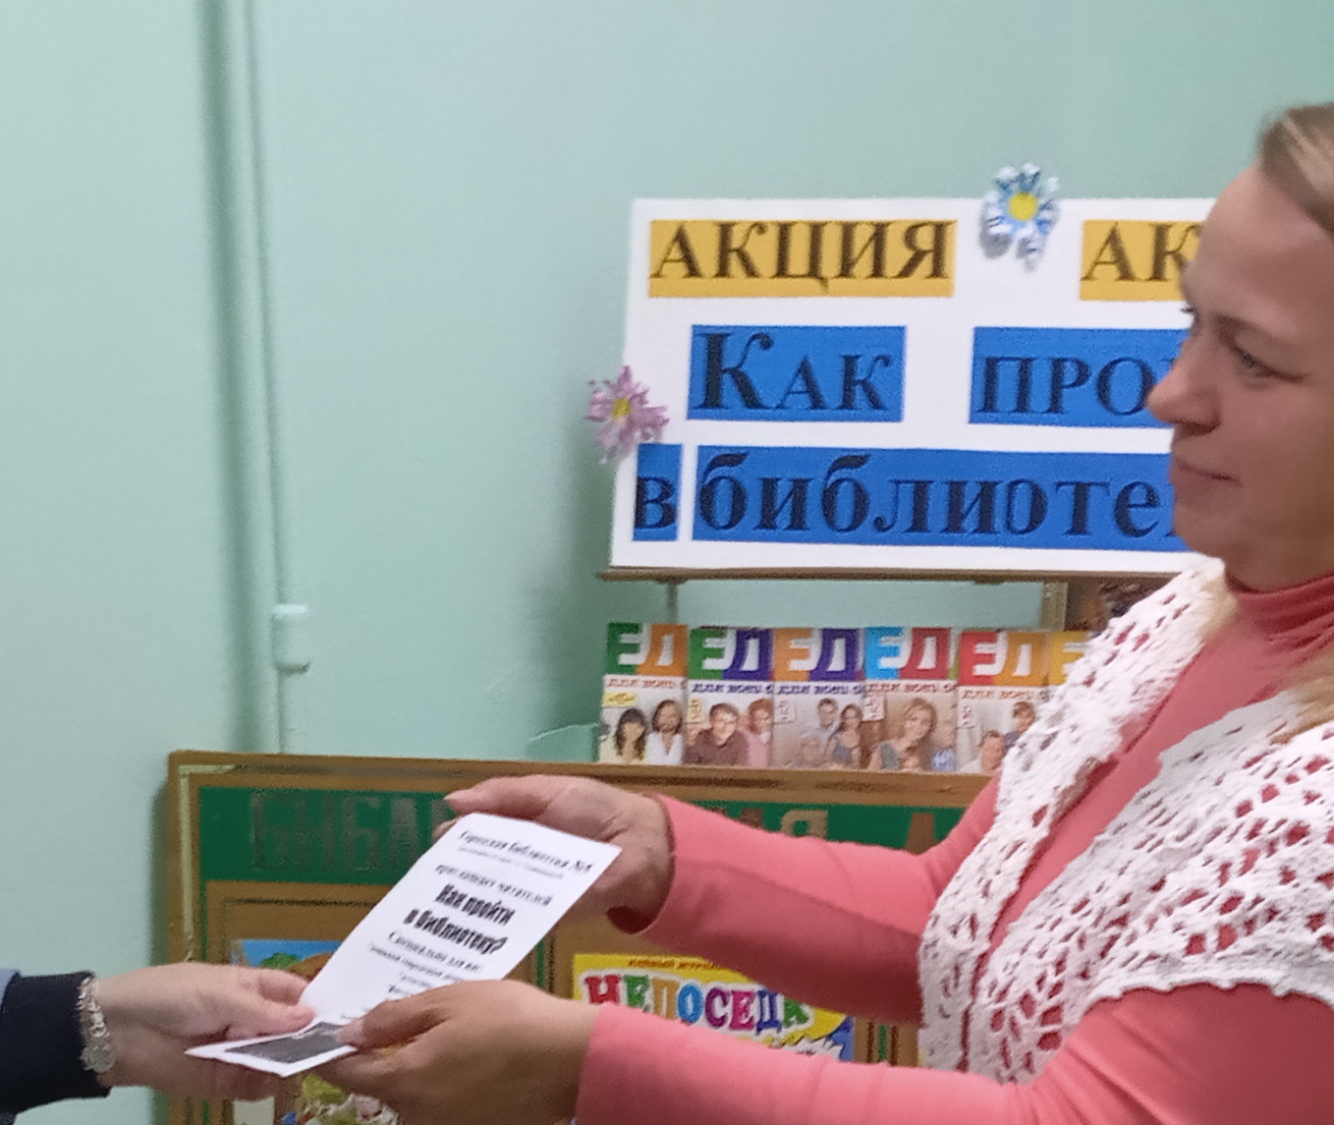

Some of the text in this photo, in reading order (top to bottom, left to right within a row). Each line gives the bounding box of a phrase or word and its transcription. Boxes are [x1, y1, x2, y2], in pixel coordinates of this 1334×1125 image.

[650, 220, 957, 291] АКЦИЯ
[1080, 221, 1204, 282] АК
[977, 355, 1173, 417] ПРО
[632, 453, 1170, 539] в библиоте
[403, 908, 419, 925] в
[435, 883, 515, 926] Как пройти
